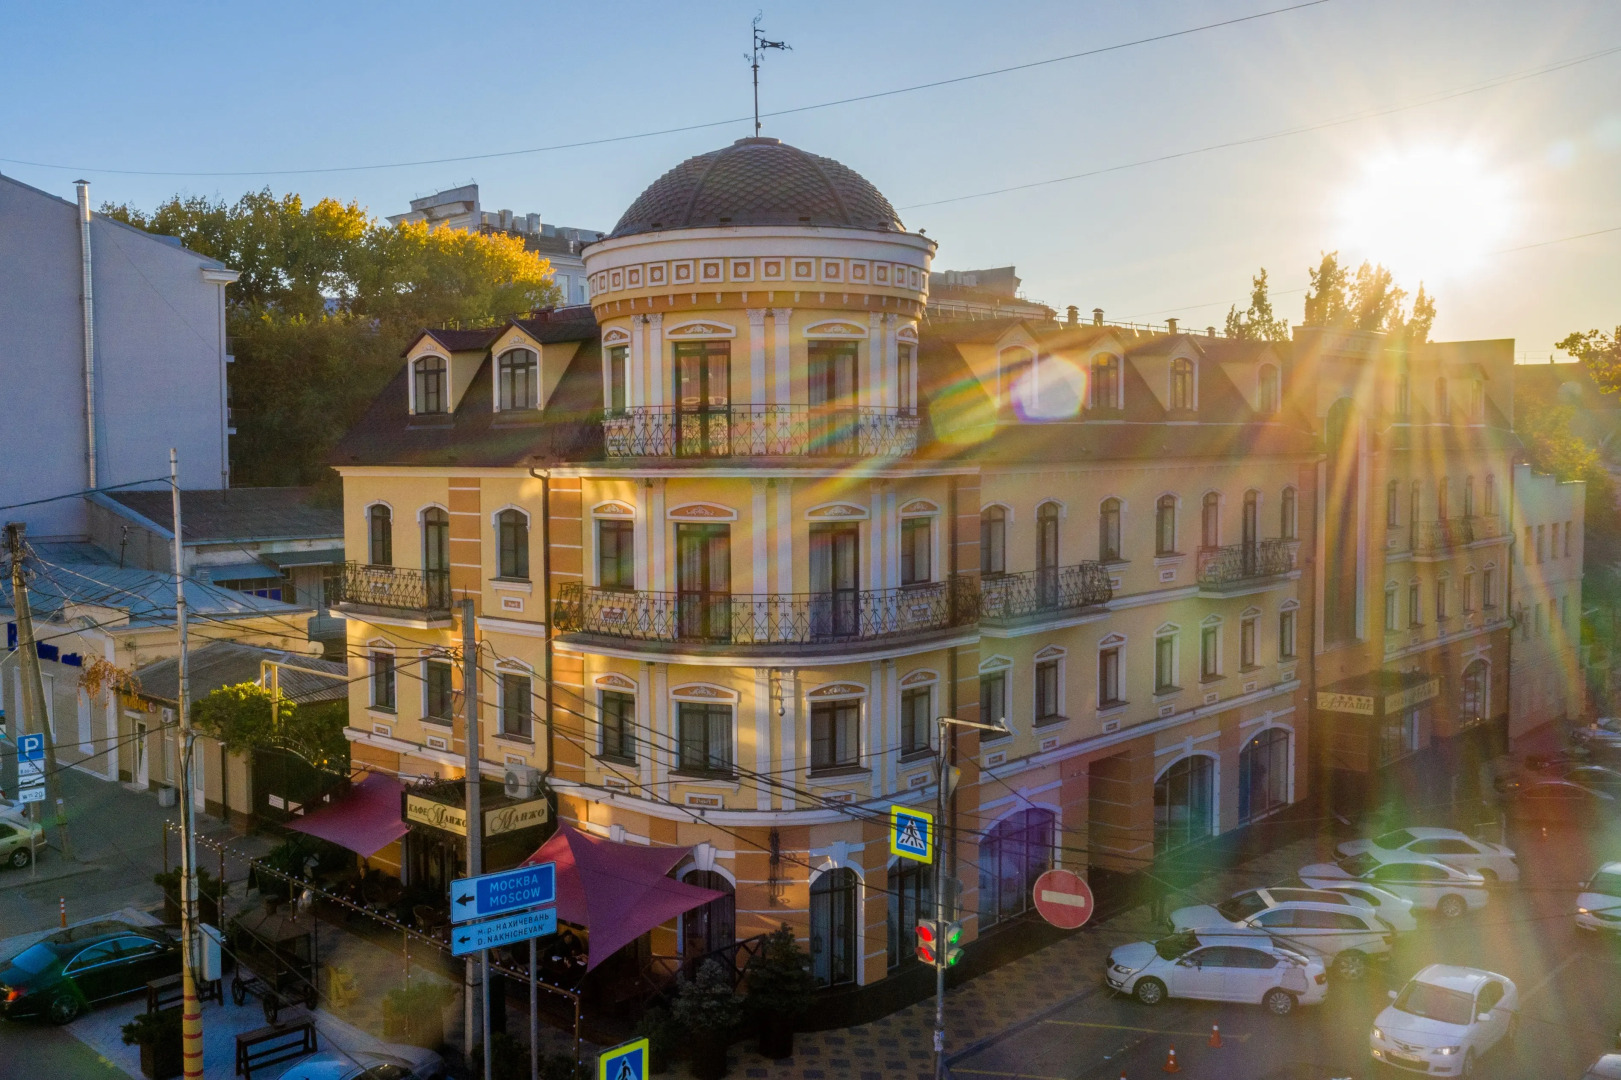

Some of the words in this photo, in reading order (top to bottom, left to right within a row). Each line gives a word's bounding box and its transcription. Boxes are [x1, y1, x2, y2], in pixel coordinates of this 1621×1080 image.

[25, 738, 39, 757] P
[408, 803, 428, 815] КАФЕ
[489, 873, 539, 893] МОСКВА
[489, 887, 541, 907] MOSCOW
[496, 913, 550, 931] НАХИЧЕВАНЬ
